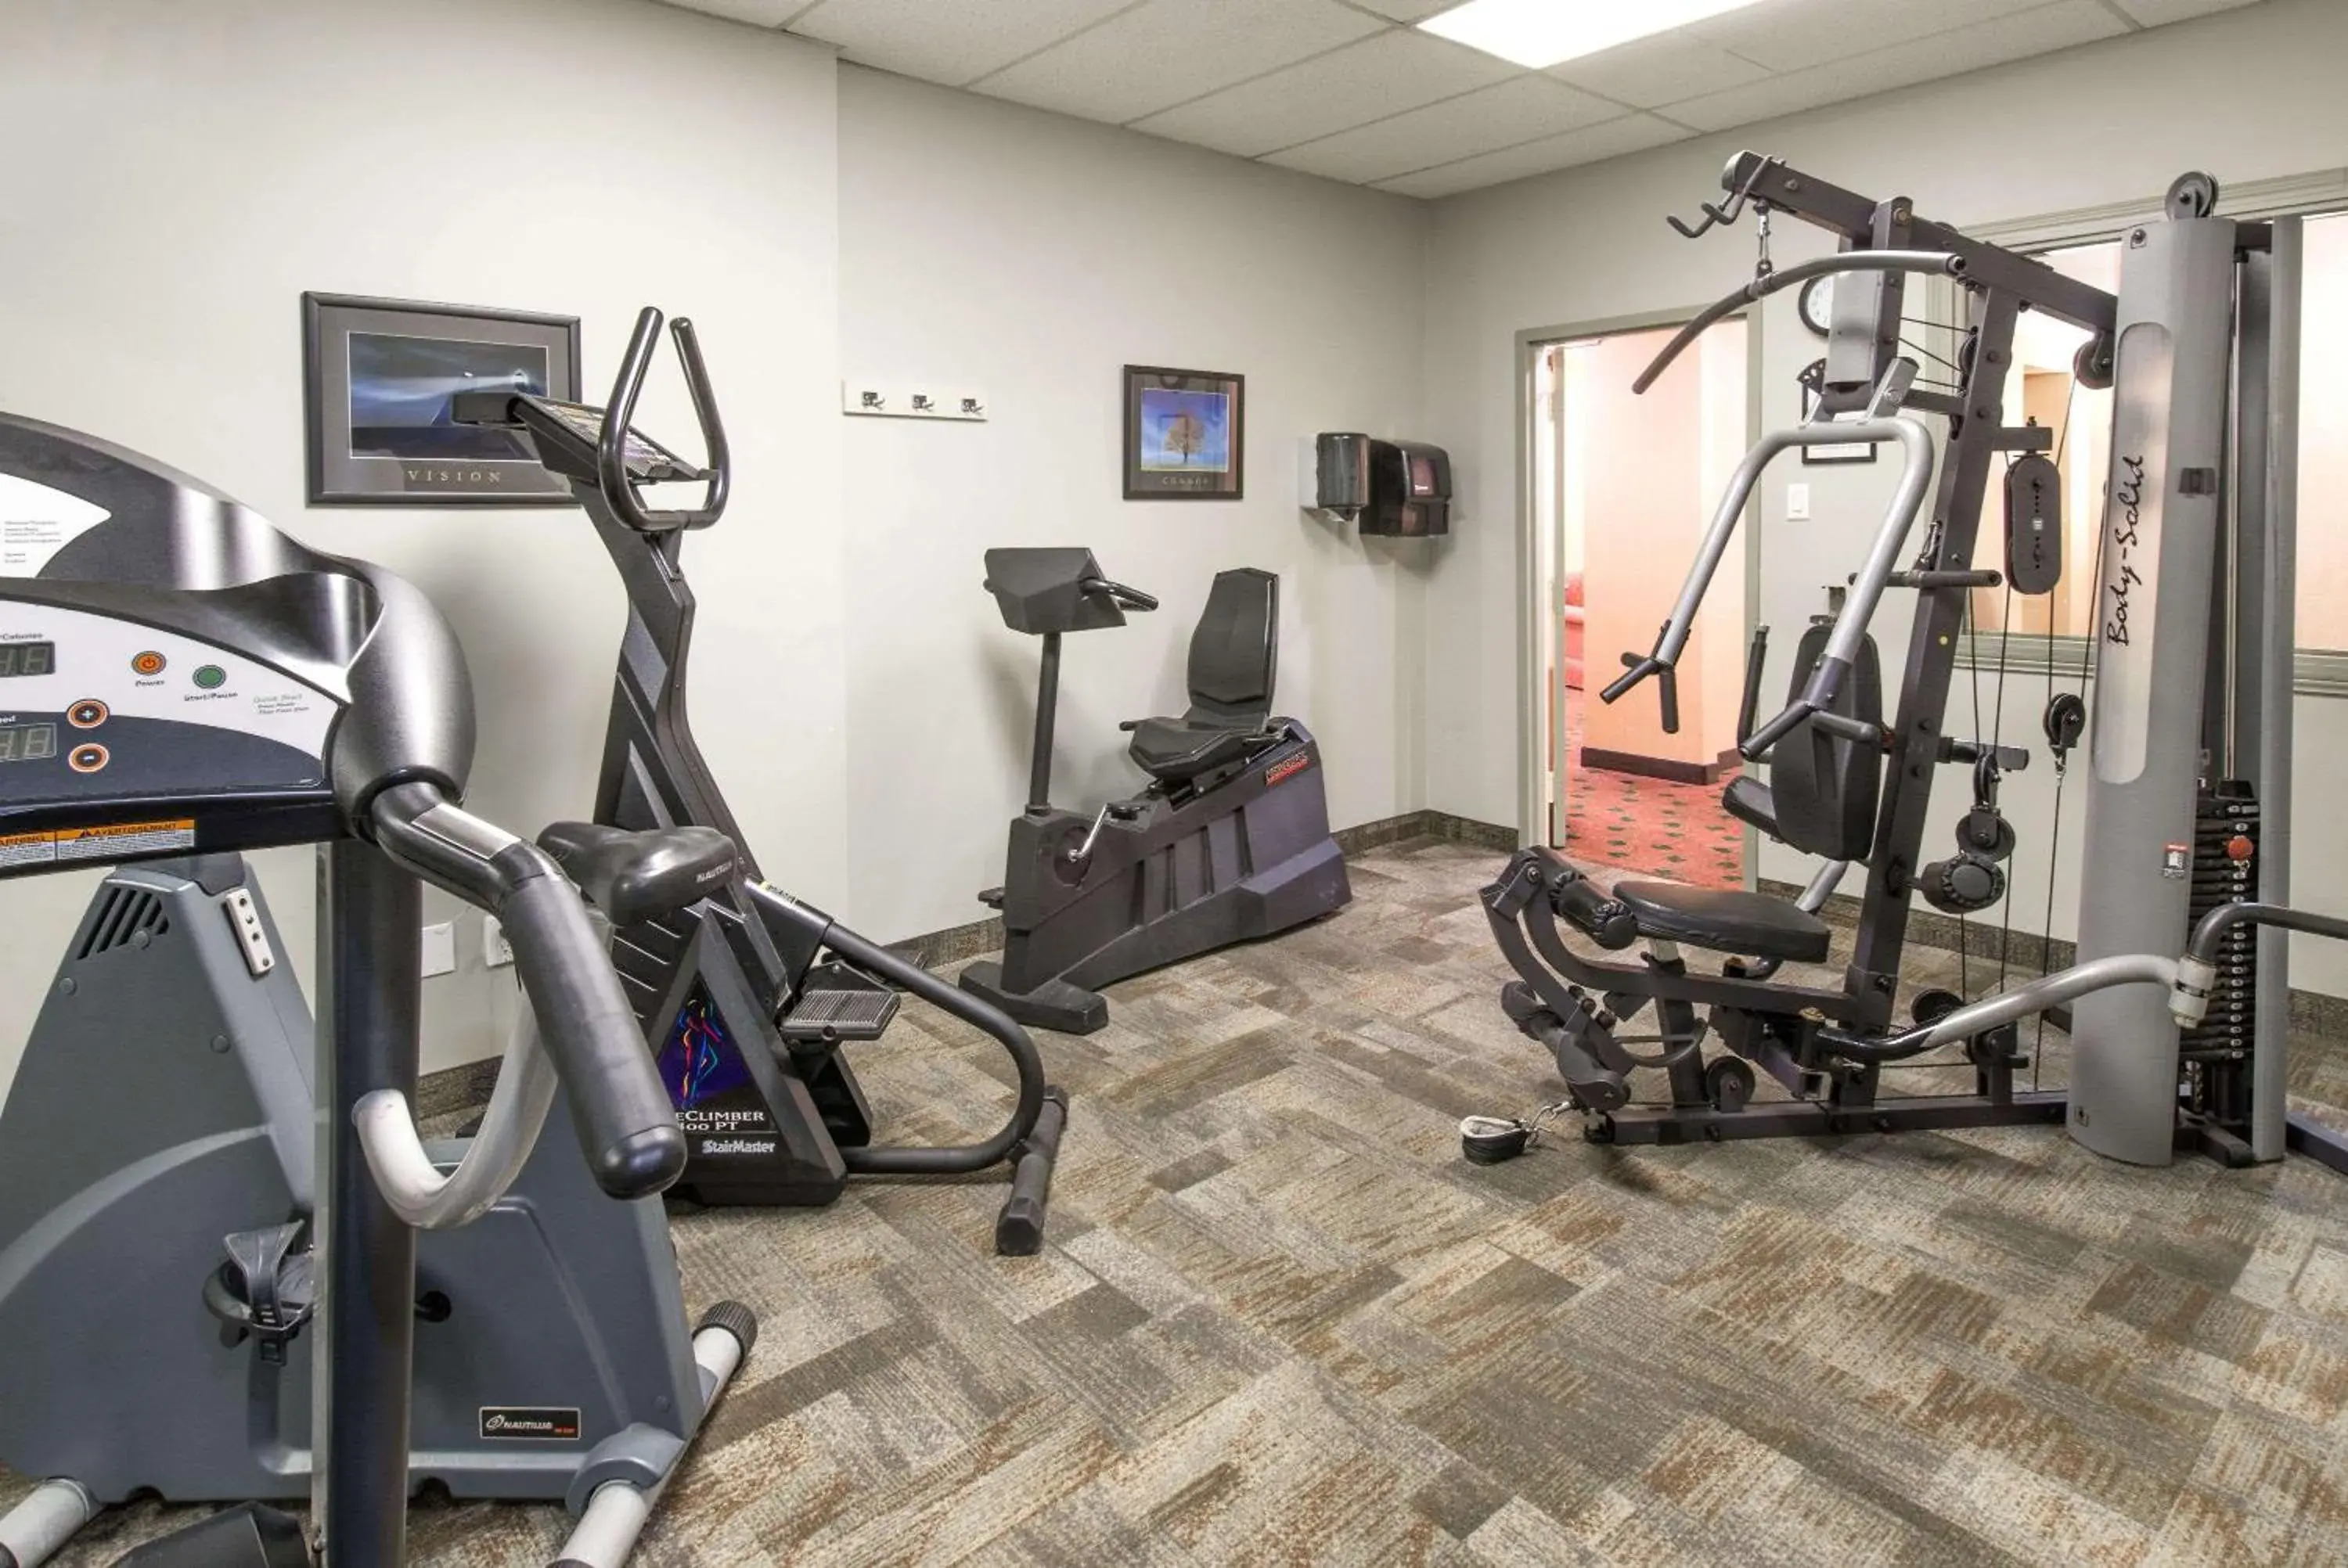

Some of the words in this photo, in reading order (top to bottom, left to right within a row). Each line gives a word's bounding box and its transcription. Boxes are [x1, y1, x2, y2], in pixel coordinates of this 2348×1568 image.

[408, 470, 501, 482] VISION
[2107, 455, 2145, 646] Body-Solid
[715, 1121, 739, 1131] PT
[703, 1139, 776, 1154] StairMaster
[504, 1421, 553, 1430] NAUTILUS
